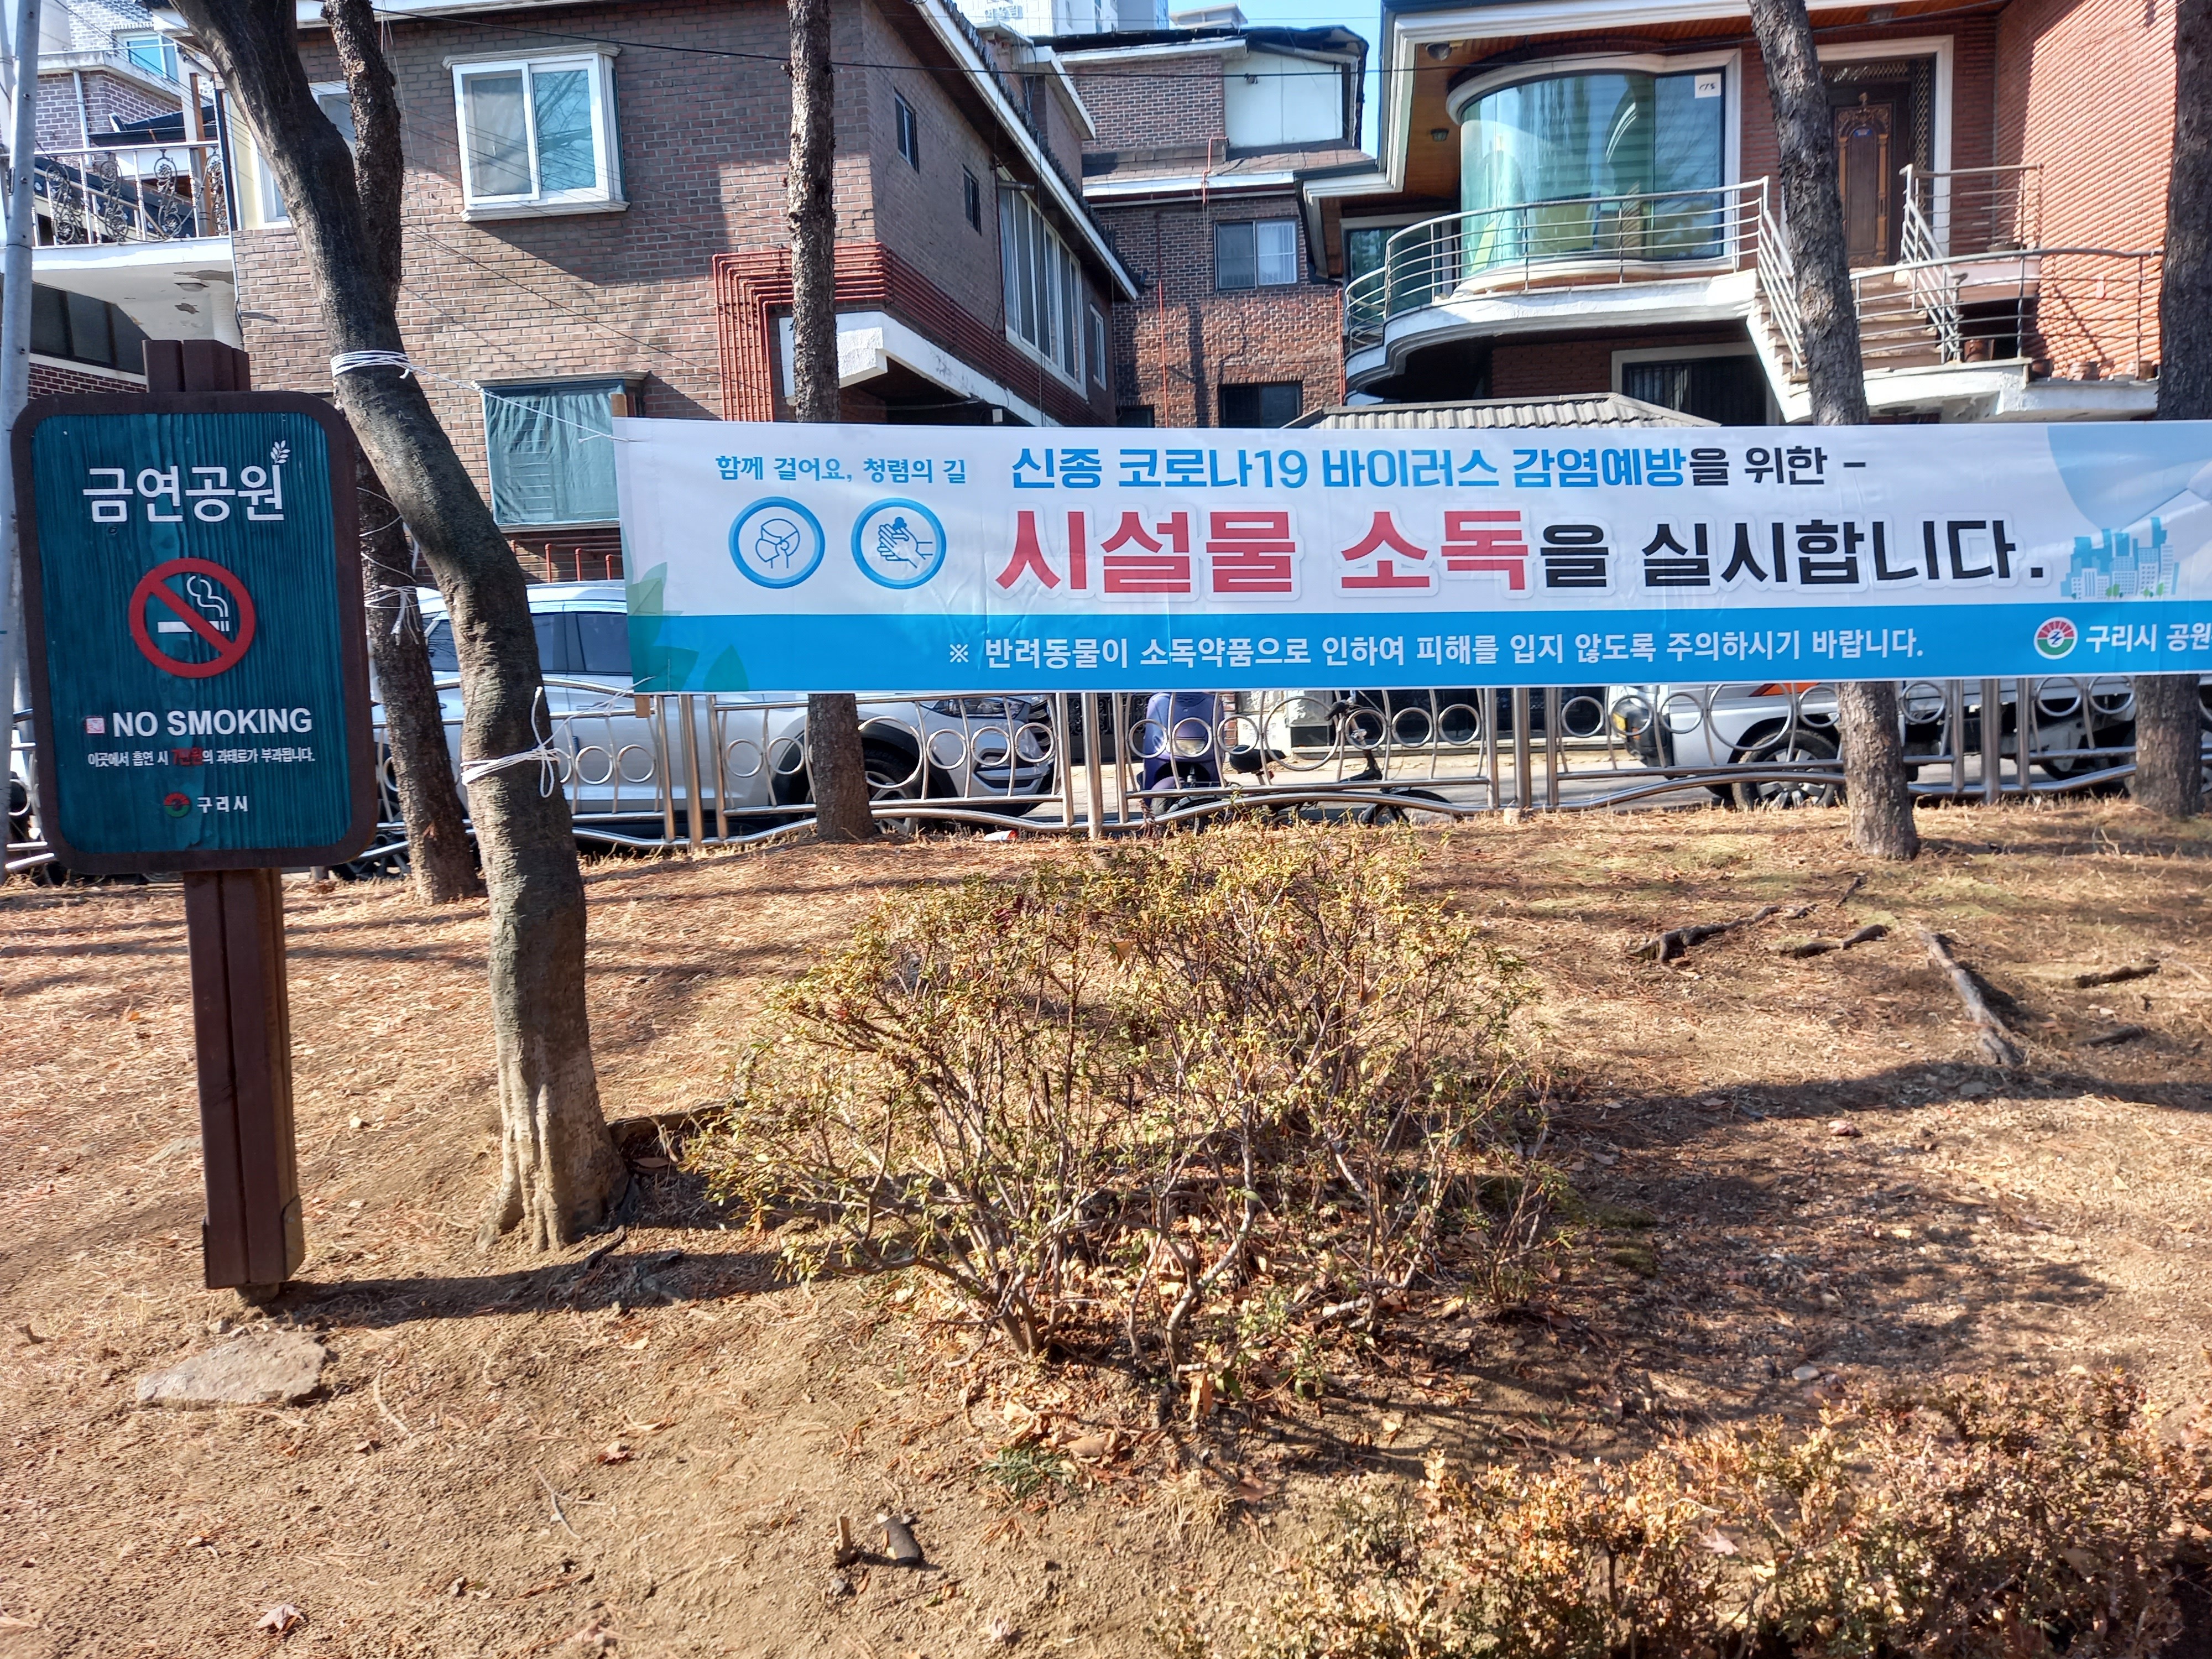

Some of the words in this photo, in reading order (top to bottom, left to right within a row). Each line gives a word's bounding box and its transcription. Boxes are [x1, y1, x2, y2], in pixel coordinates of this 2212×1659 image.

[715, 455, 764, 481] 함께
[774, 457, 852, 482] 걸어요,
[863, 458, 933, 484] 청렴의
[943, 459, 966, 484] 길
[1012, 448, 1102, 489] 신종
[1118, 448, 1308, 489] 코로나19
[1322, 449, 1500, 487] 바이러스
[1512, 448, 1730, 488] 감염예방을
[1744, 445, 1828, 486] 위한
[83, 465, 284, 522] 금연공원
[996, 510, 1296, 593] 시설물
[1341, 510, 1609, 590] 소독을
[1642, 519, 2043, 587] 실시합니다.
[986, 638, 1127, 669] 반려동물이
[1140, 638, 1311, 668] 소독약품으로
[1322, 636, 1404, 666] 인하여
[1417, 635, 1499, 665] 피해를
[1510, 634, 1563, 664] 입지
[1575, 633, 1656, 663] 않도록
[1667, 630, 1799, 661] 주의하시기
[1813, 629, 1923, 659] 바랍니다.
[2085, 624, 2157, 653] 구리시
[113, 711, 158, 737] NO
[167, 708, 312, 735] SMOKING
[87, 752, 129, 767] 이곳에서
[132, 750, 154, 766] 흡연
[156, 750, 169, 765] 시
[216, 748, 258, 764] 과태료가
[261, 747, 316, 763] 부과됩니다.
[197, 795, 248, 813] 구리시
